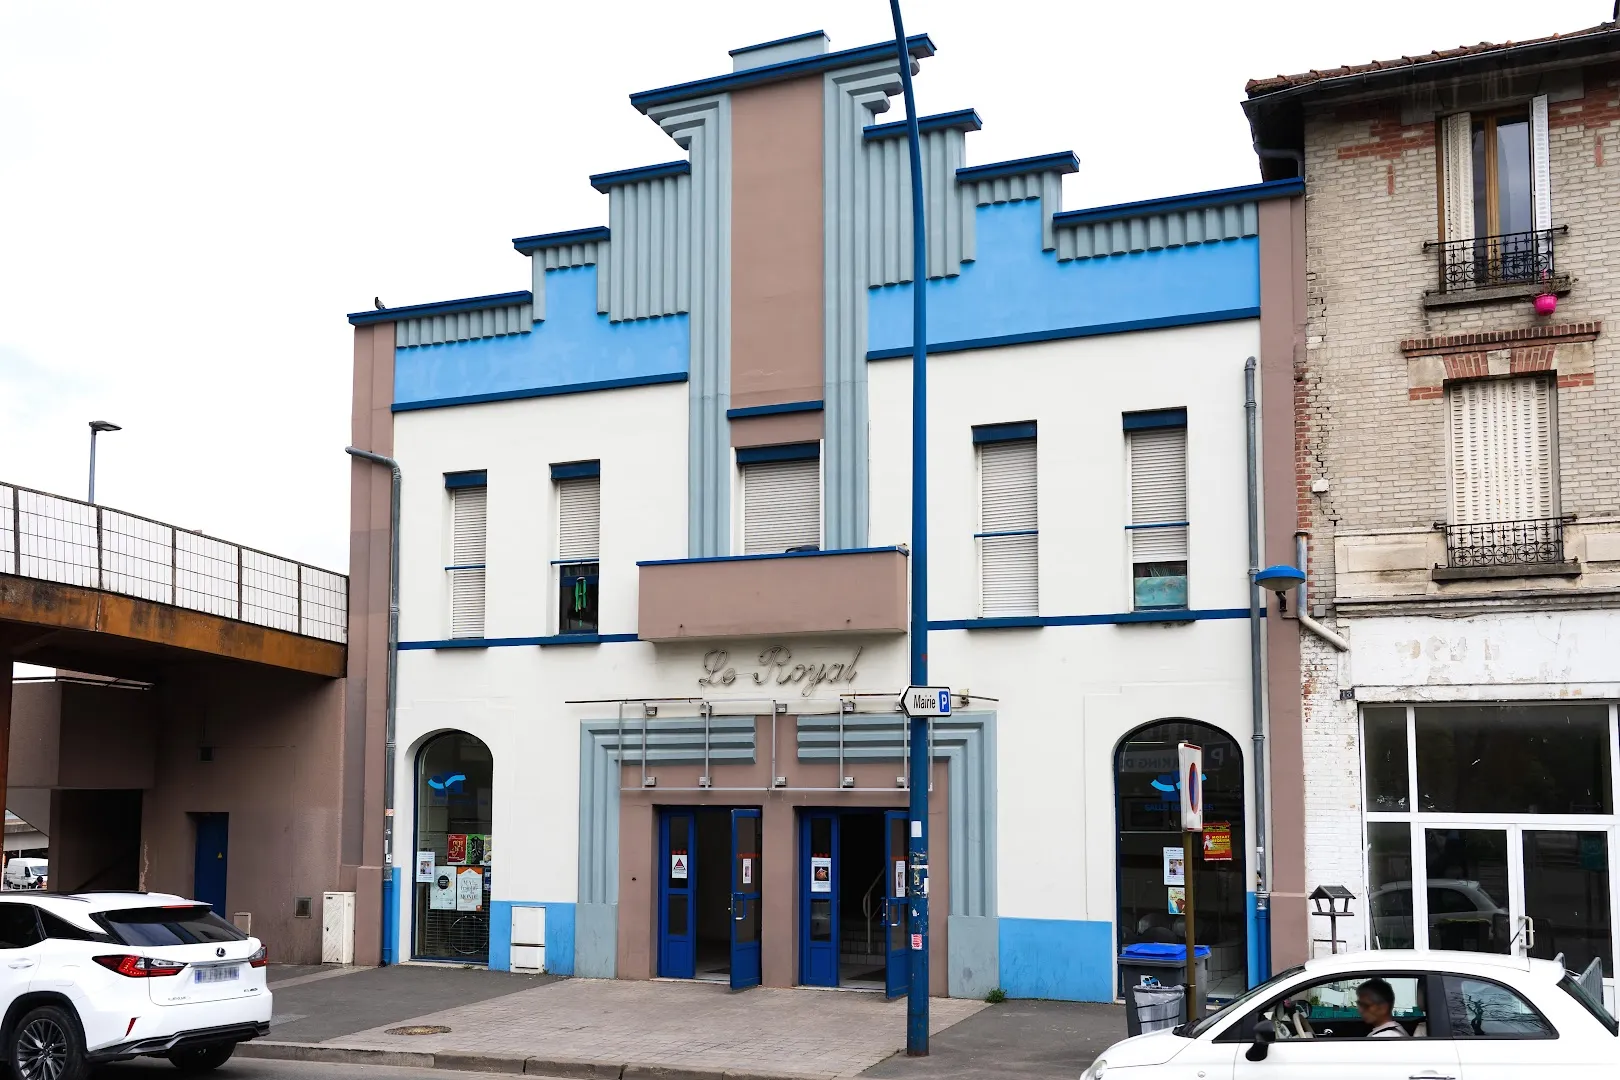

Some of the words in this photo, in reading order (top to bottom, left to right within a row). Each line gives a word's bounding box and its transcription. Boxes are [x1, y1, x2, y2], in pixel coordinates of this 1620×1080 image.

[698, 649, 736, 686] Le
[753, 645, 863, 698] Royal
[914, 694, 936, 709] Mairie
[941, 694, 947, 710] P
